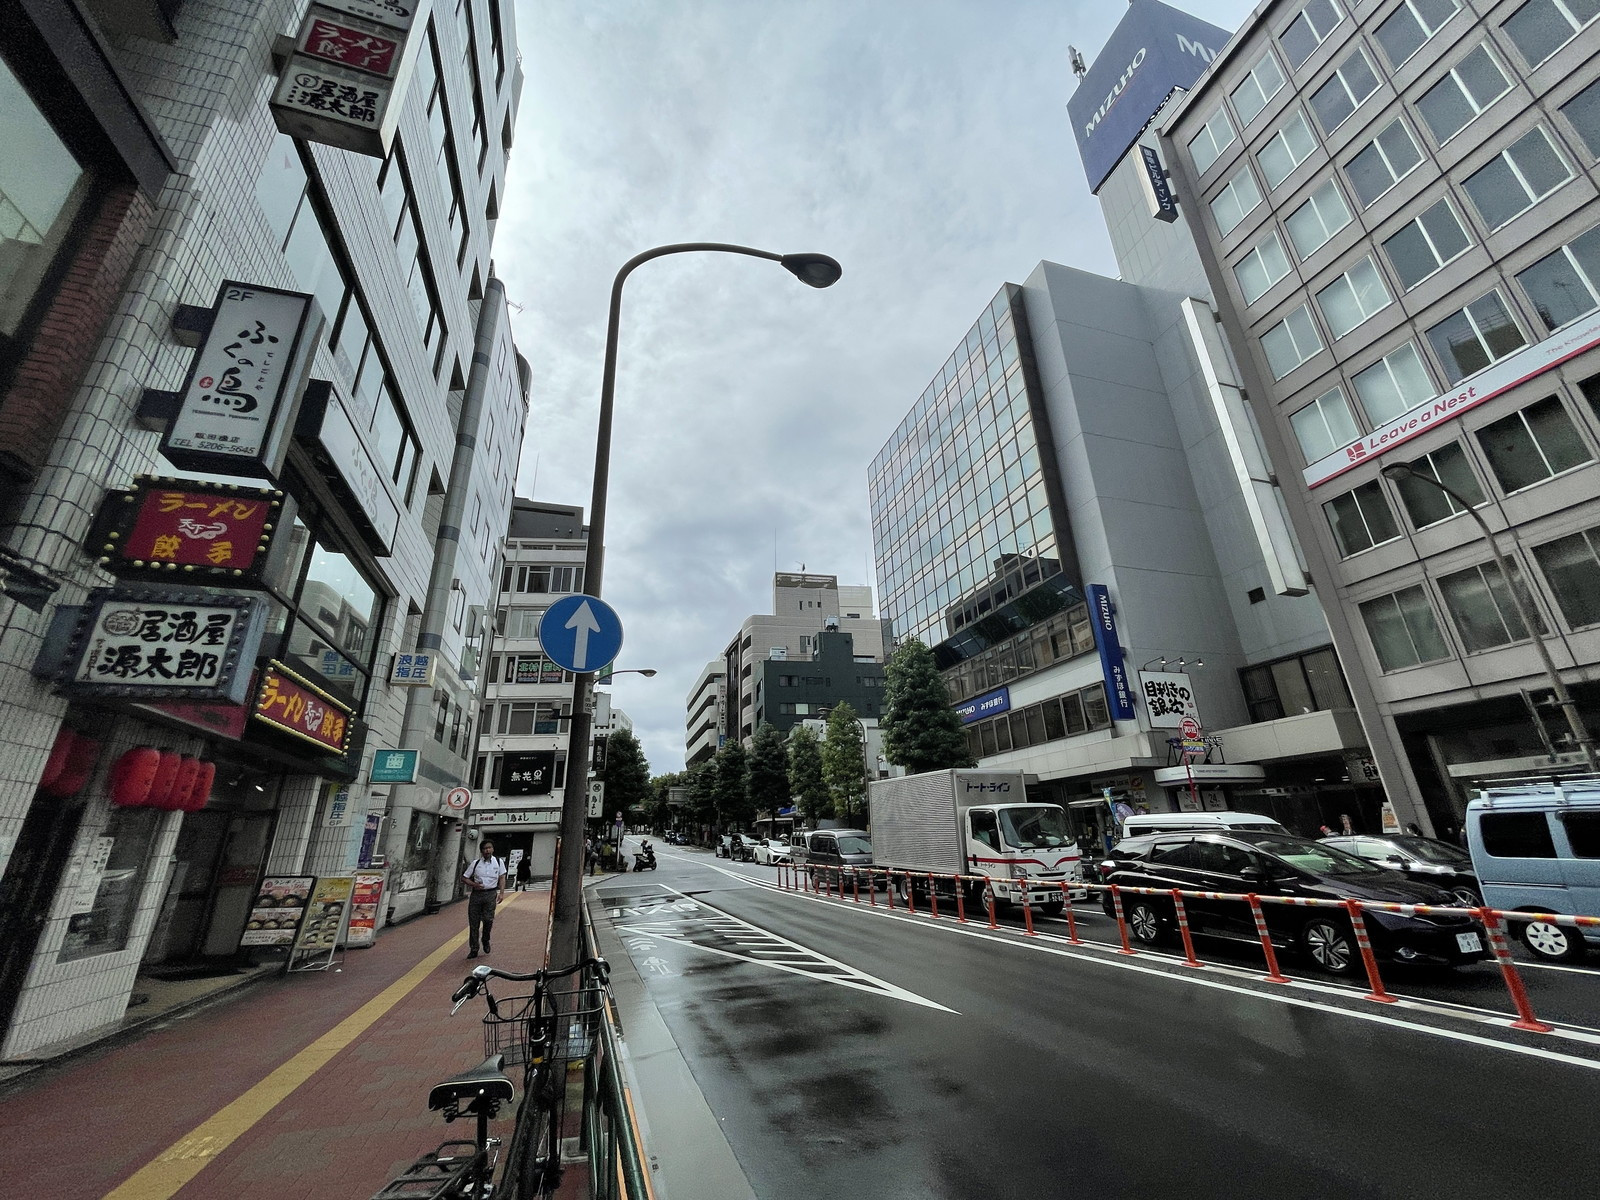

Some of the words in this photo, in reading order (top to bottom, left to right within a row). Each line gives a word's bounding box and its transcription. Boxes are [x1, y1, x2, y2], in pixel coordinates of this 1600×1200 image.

[316, 25, 392, 53] ラーメン
[300, 91, 376, 122] 源太郎
[313, 79, 379, 109] 居酒屋
[1085, 47, 1146, 137] MIZUHO
[227, 290, 254, 302] 2F
[1369, 416, 1418, 450] Leave
[1420, 410, 1432, 423] a
[1433, 386, 1478, 418] Nest
[174, 437, 193, 447] TEL
[197, 440, 256, 454] 5206-5645
[159, 492, 257, 520] ラーメン
[1099, 594, 1113, 631] MIZUHO
[132, 610, 232, 646] 居酒屋
[97, 644, 219, 681] 源太郎
[395, 666, 427, 679] 指圧
[262, 678, 306, 723] ラーメン
[1113, 665, 1128, 708] みずほ銀行
[1144, 680, 1191, 701] 目利きの
[1148, 697, 1185, 716] 銀次
[510, 769, 543, 782] 無花果
